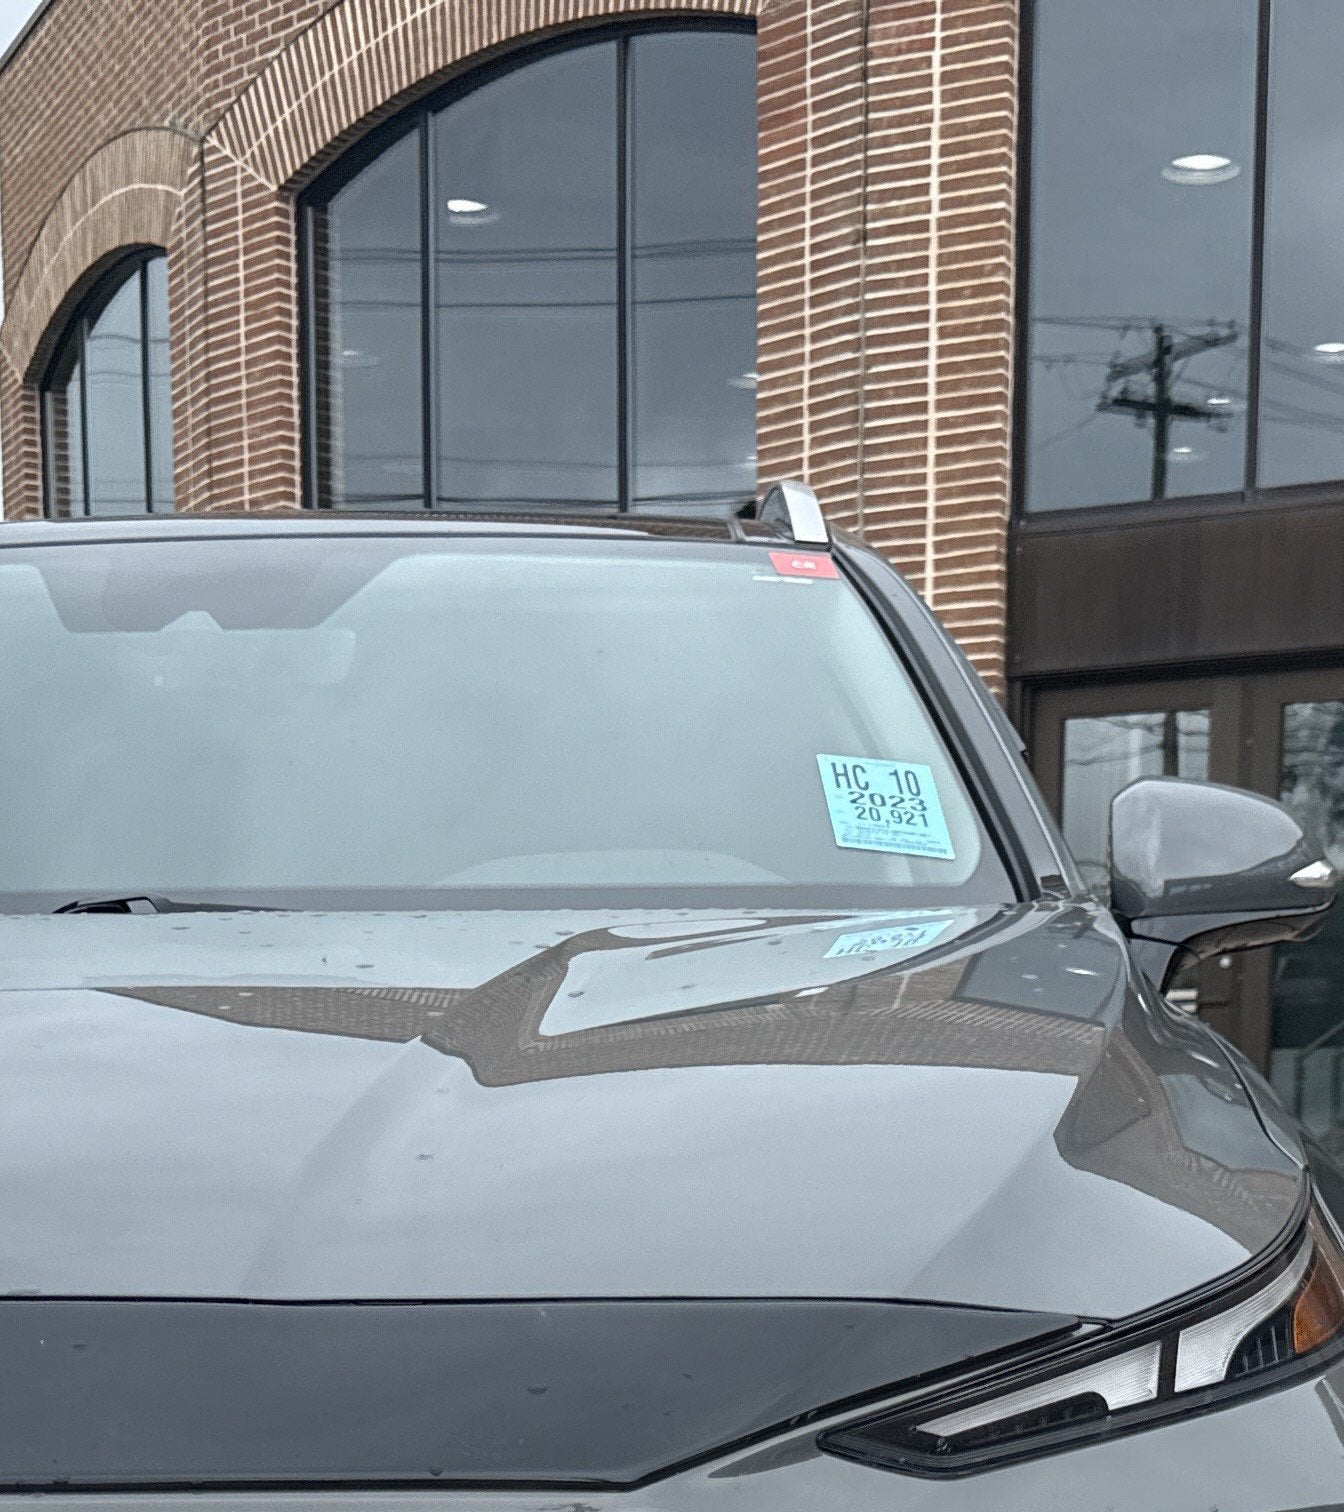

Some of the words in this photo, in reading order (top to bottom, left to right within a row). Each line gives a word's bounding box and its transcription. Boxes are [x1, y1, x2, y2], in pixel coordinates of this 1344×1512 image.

[831, 762, 870, 791] HC
[889, 769, 921, 797] 10
[847, 791, 928, 812] 2023
[855, 806, 928, 828] 20,921
